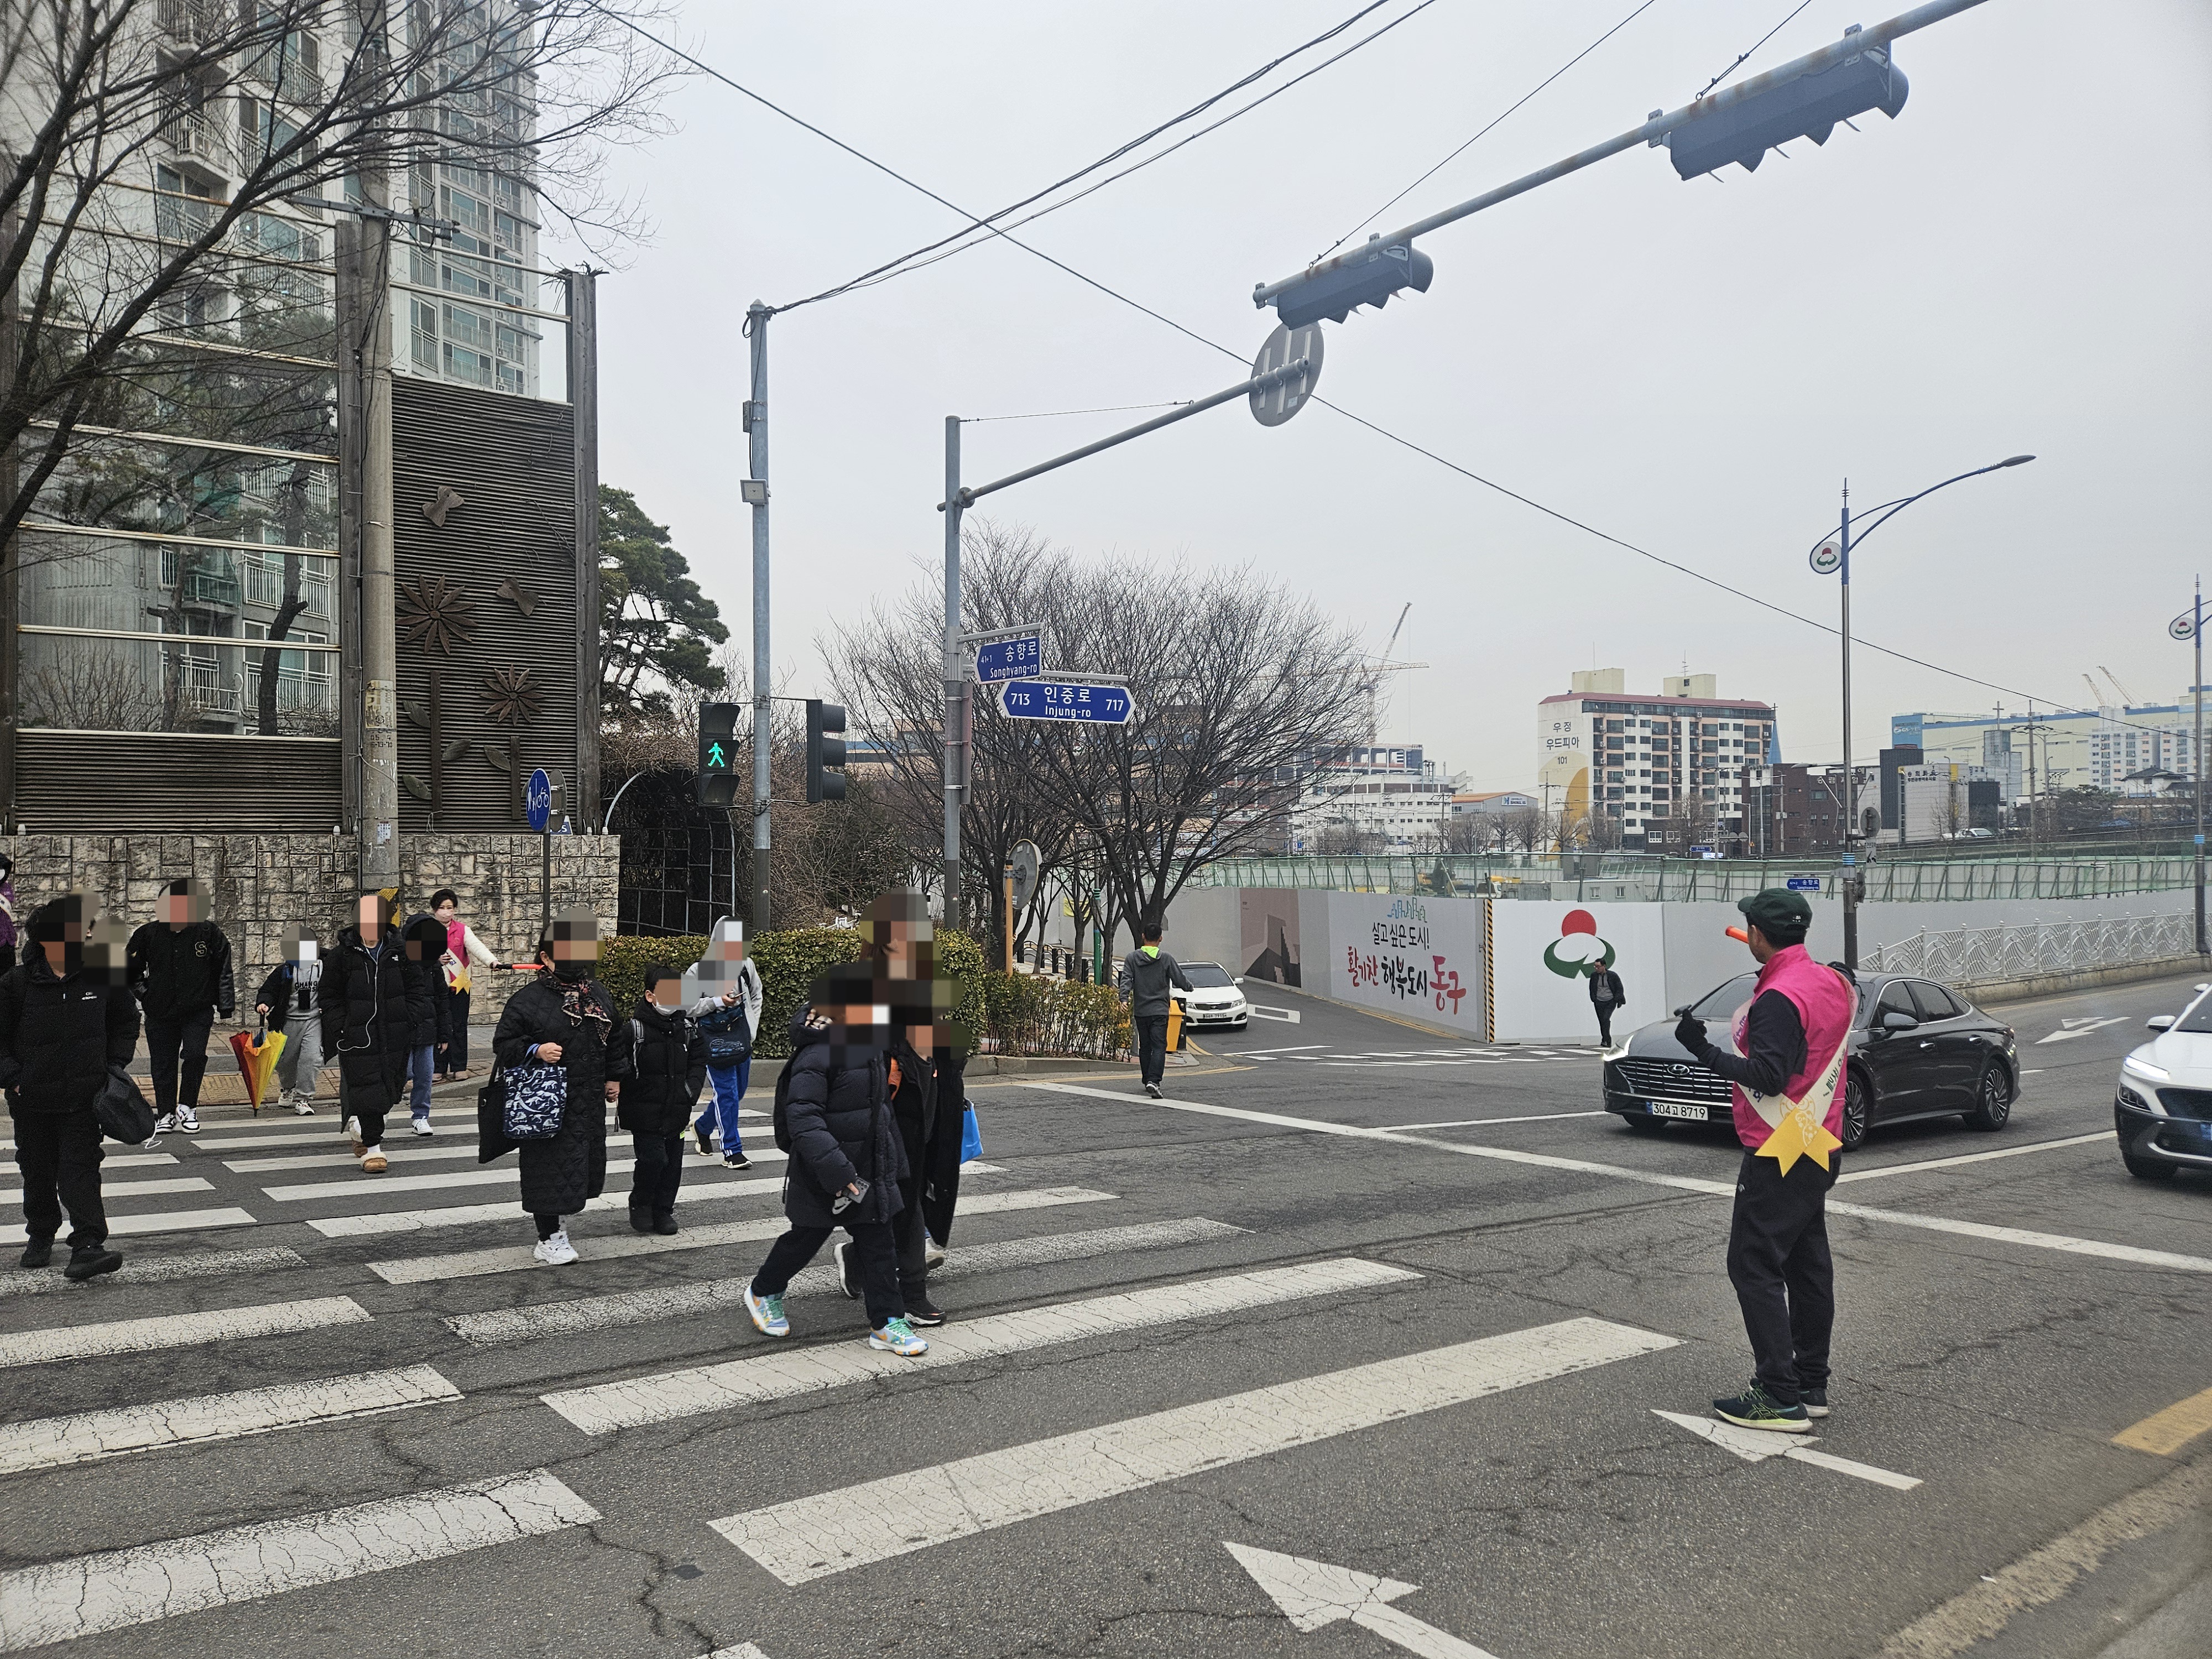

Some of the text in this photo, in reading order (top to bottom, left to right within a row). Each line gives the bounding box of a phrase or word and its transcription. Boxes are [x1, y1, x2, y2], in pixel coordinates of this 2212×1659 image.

[1005, 641, 1037, 662] 송향로
[990, 664, 1037, 678] Songhyang-ro
[1011, 693, 1030, 706] 713
[1044, 687, 1091, 704] 인중로
[1045, 705, 1091, 718] Injung-ro
[1106, 700, 1124, 711] 717
[1553, 722, 1571, 733] 우정
[1546, 737, 1579, 750] 우드피아
[1373, 922, 1430, 951] 살고 싶은 도시!
[1348, 946, 1379, 987] 활기찬
[1430, 955, 1467, 1015] 동구
[1681, 1107, 1705, 1119] 8719
